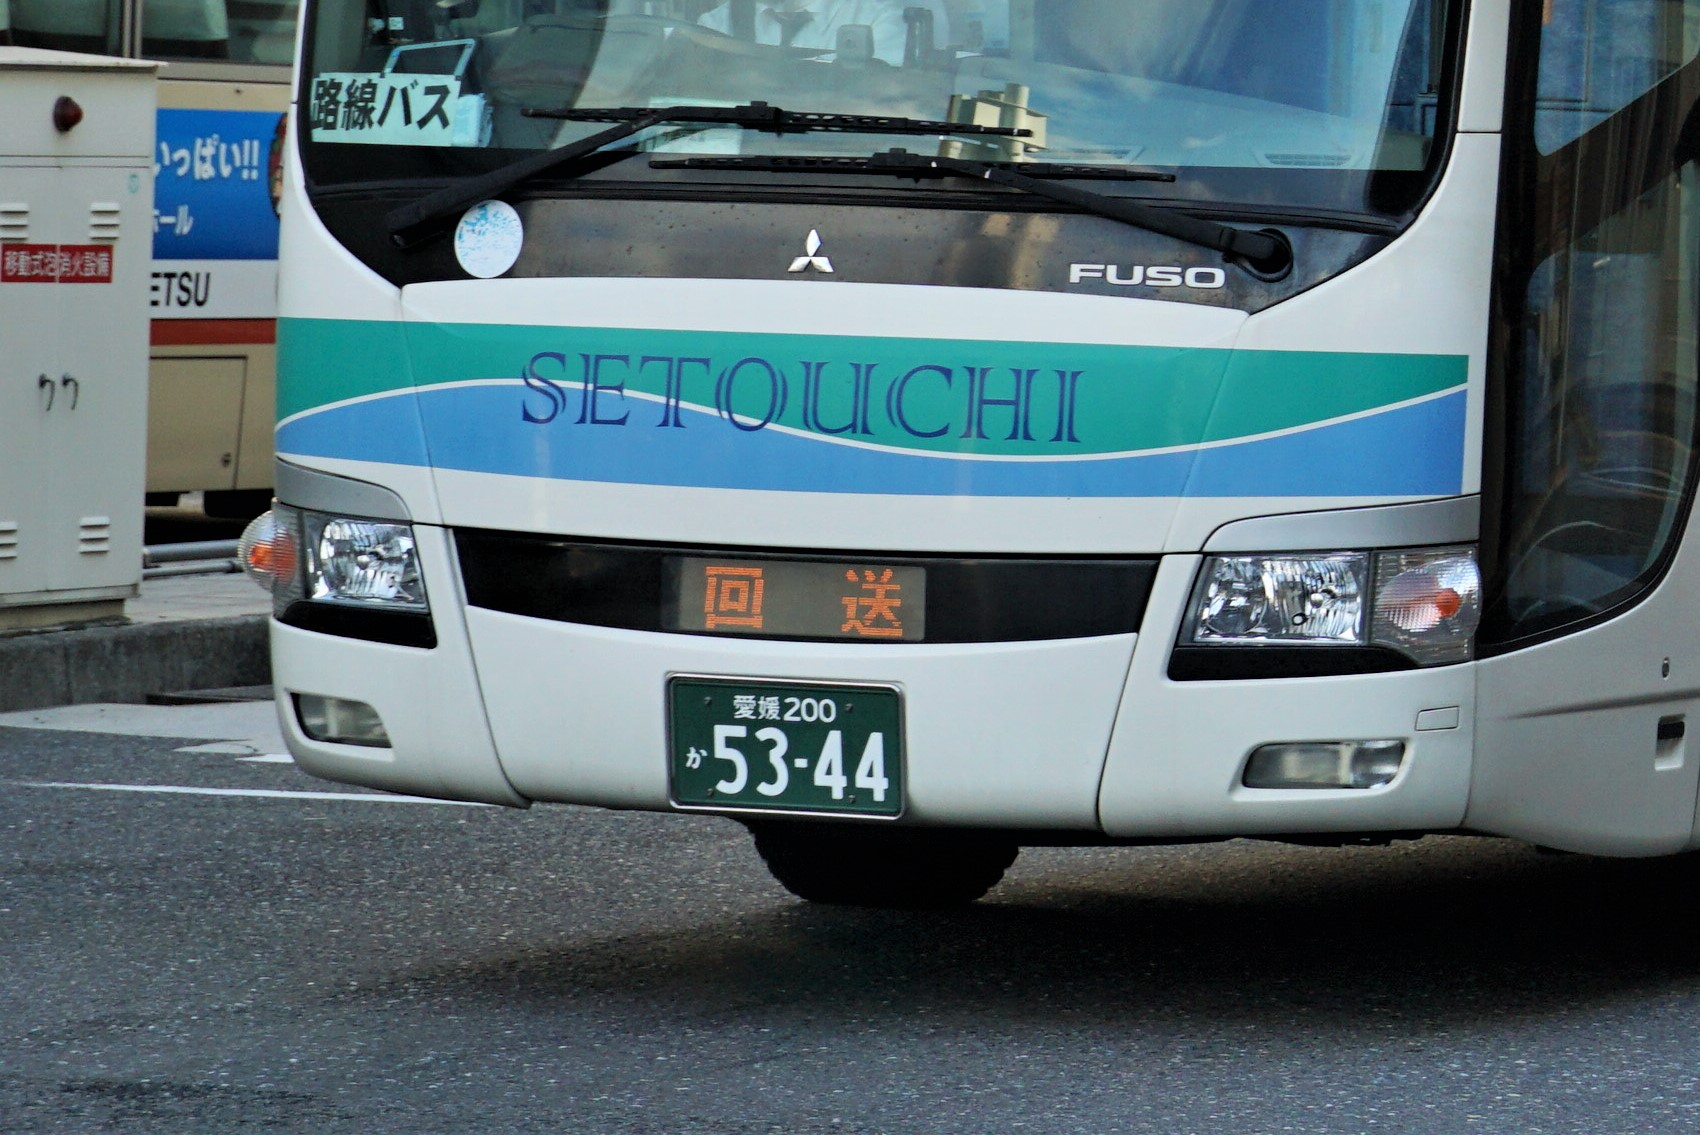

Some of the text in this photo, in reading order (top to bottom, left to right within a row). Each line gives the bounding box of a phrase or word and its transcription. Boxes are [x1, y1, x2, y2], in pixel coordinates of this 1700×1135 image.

[311, 77, 451, 131] 路線バス
[1069, 262, 1226, 290] FUSO
[522, 350, 1086, 444] SETOUCHI
[704, 566, 903, 637] 回送
[685, 724, 889, 802] か 53-44
